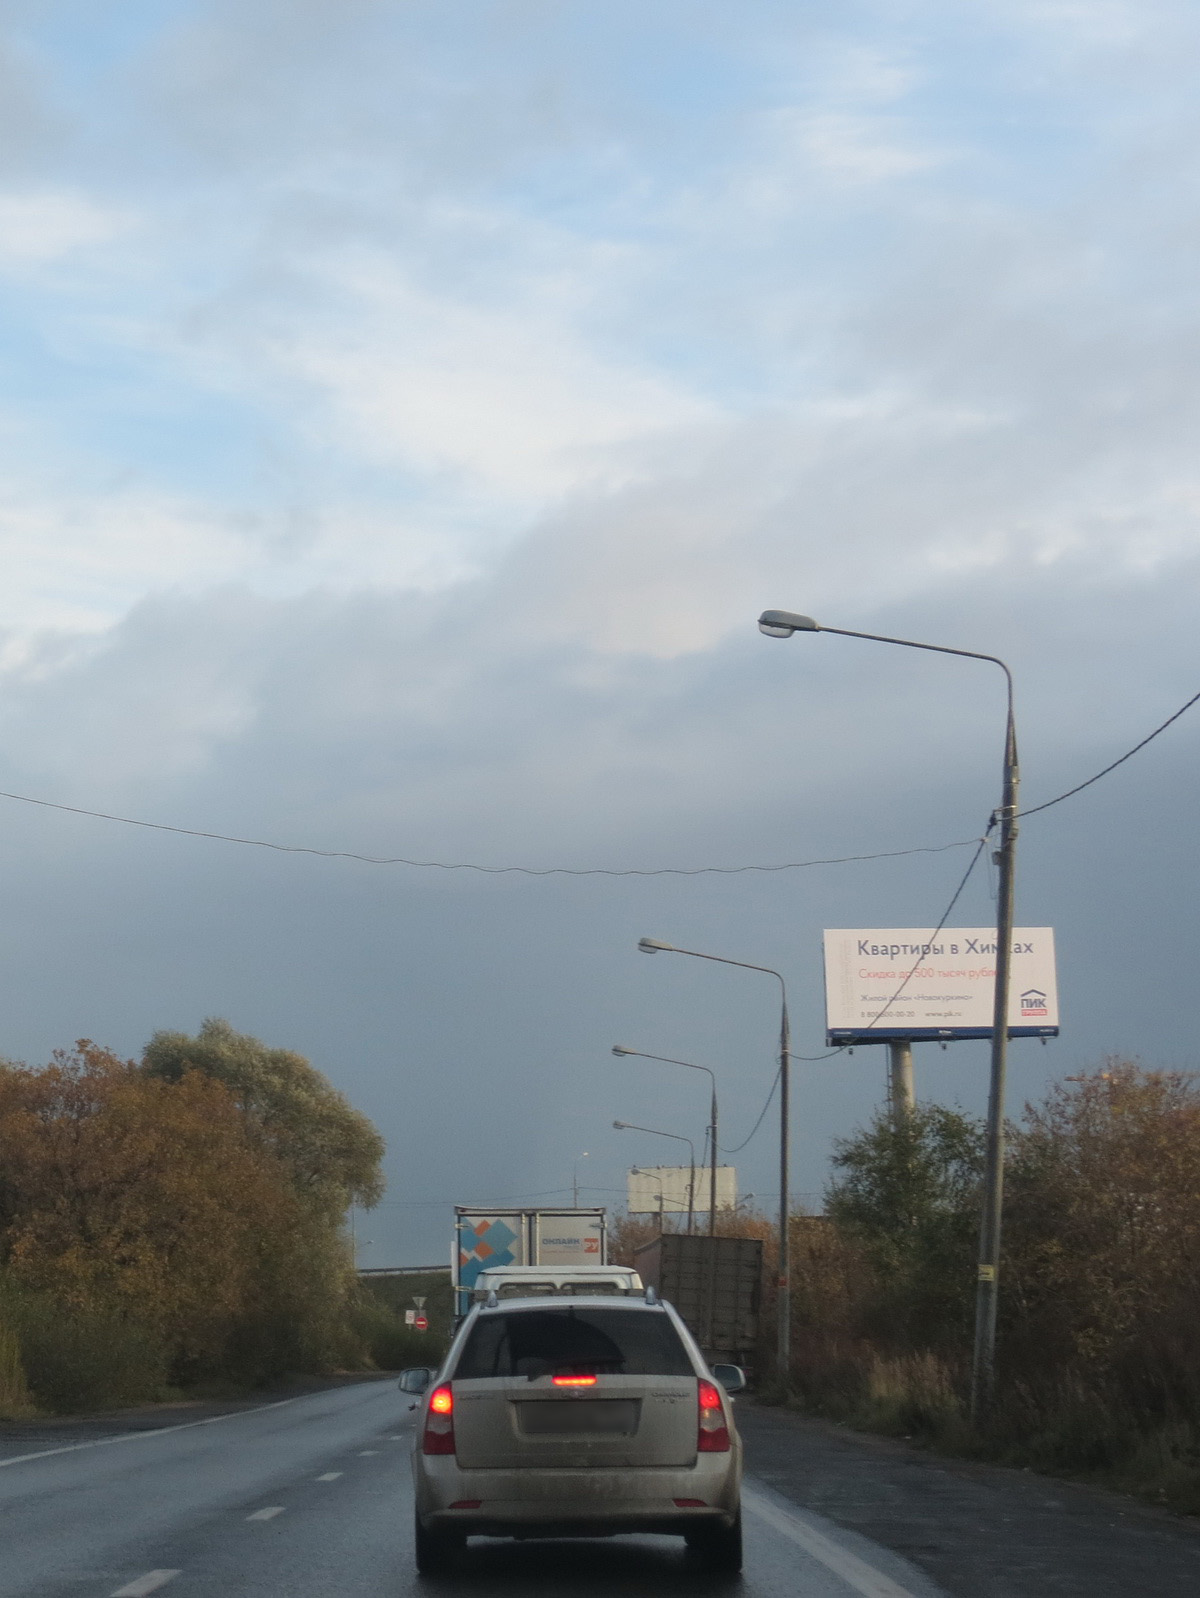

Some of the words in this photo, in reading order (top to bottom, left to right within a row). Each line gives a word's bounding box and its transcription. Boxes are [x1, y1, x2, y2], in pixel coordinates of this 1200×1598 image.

[857, 939, 944, 961] Квартиры
[950, 943, 959, 955] в
[859, 968, 896, 979] Скидка
[914, 967, 934, 978] 500
[1020, 998, 1047, 1008] ПИК
